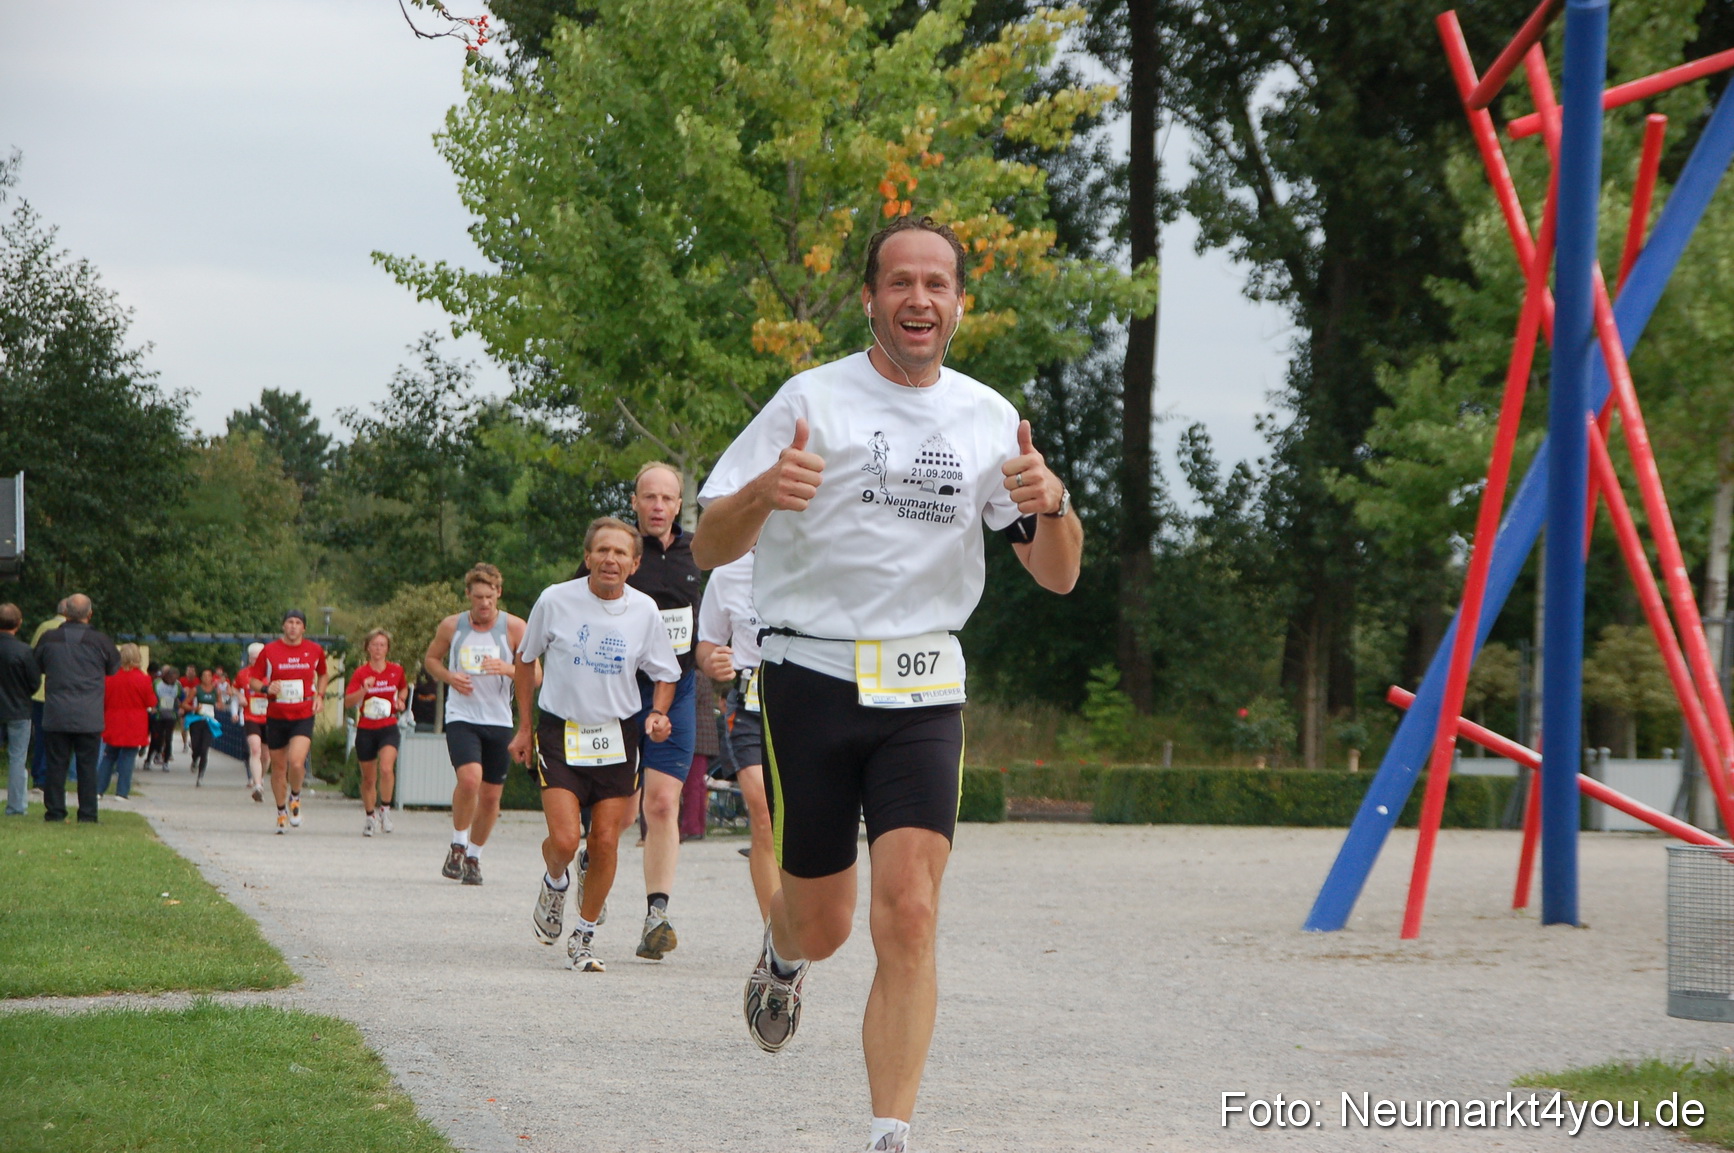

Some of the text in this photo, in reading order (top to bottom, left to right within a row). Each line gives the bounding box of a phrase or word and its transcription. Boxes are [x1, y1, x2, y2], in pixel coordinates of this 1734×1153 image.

[911, 467, 963, 481] 21.09.2008
[861, 489, 957, 514] 9. Neumarkter
[897, 506, 956, 524] Stadtlauf
[897, 650, 941, 677] 967
[922, 687, 961, 699] PFLEIDERER
[581, 727, 602, 735] Josef
[592, 737, 609, 750] 68
